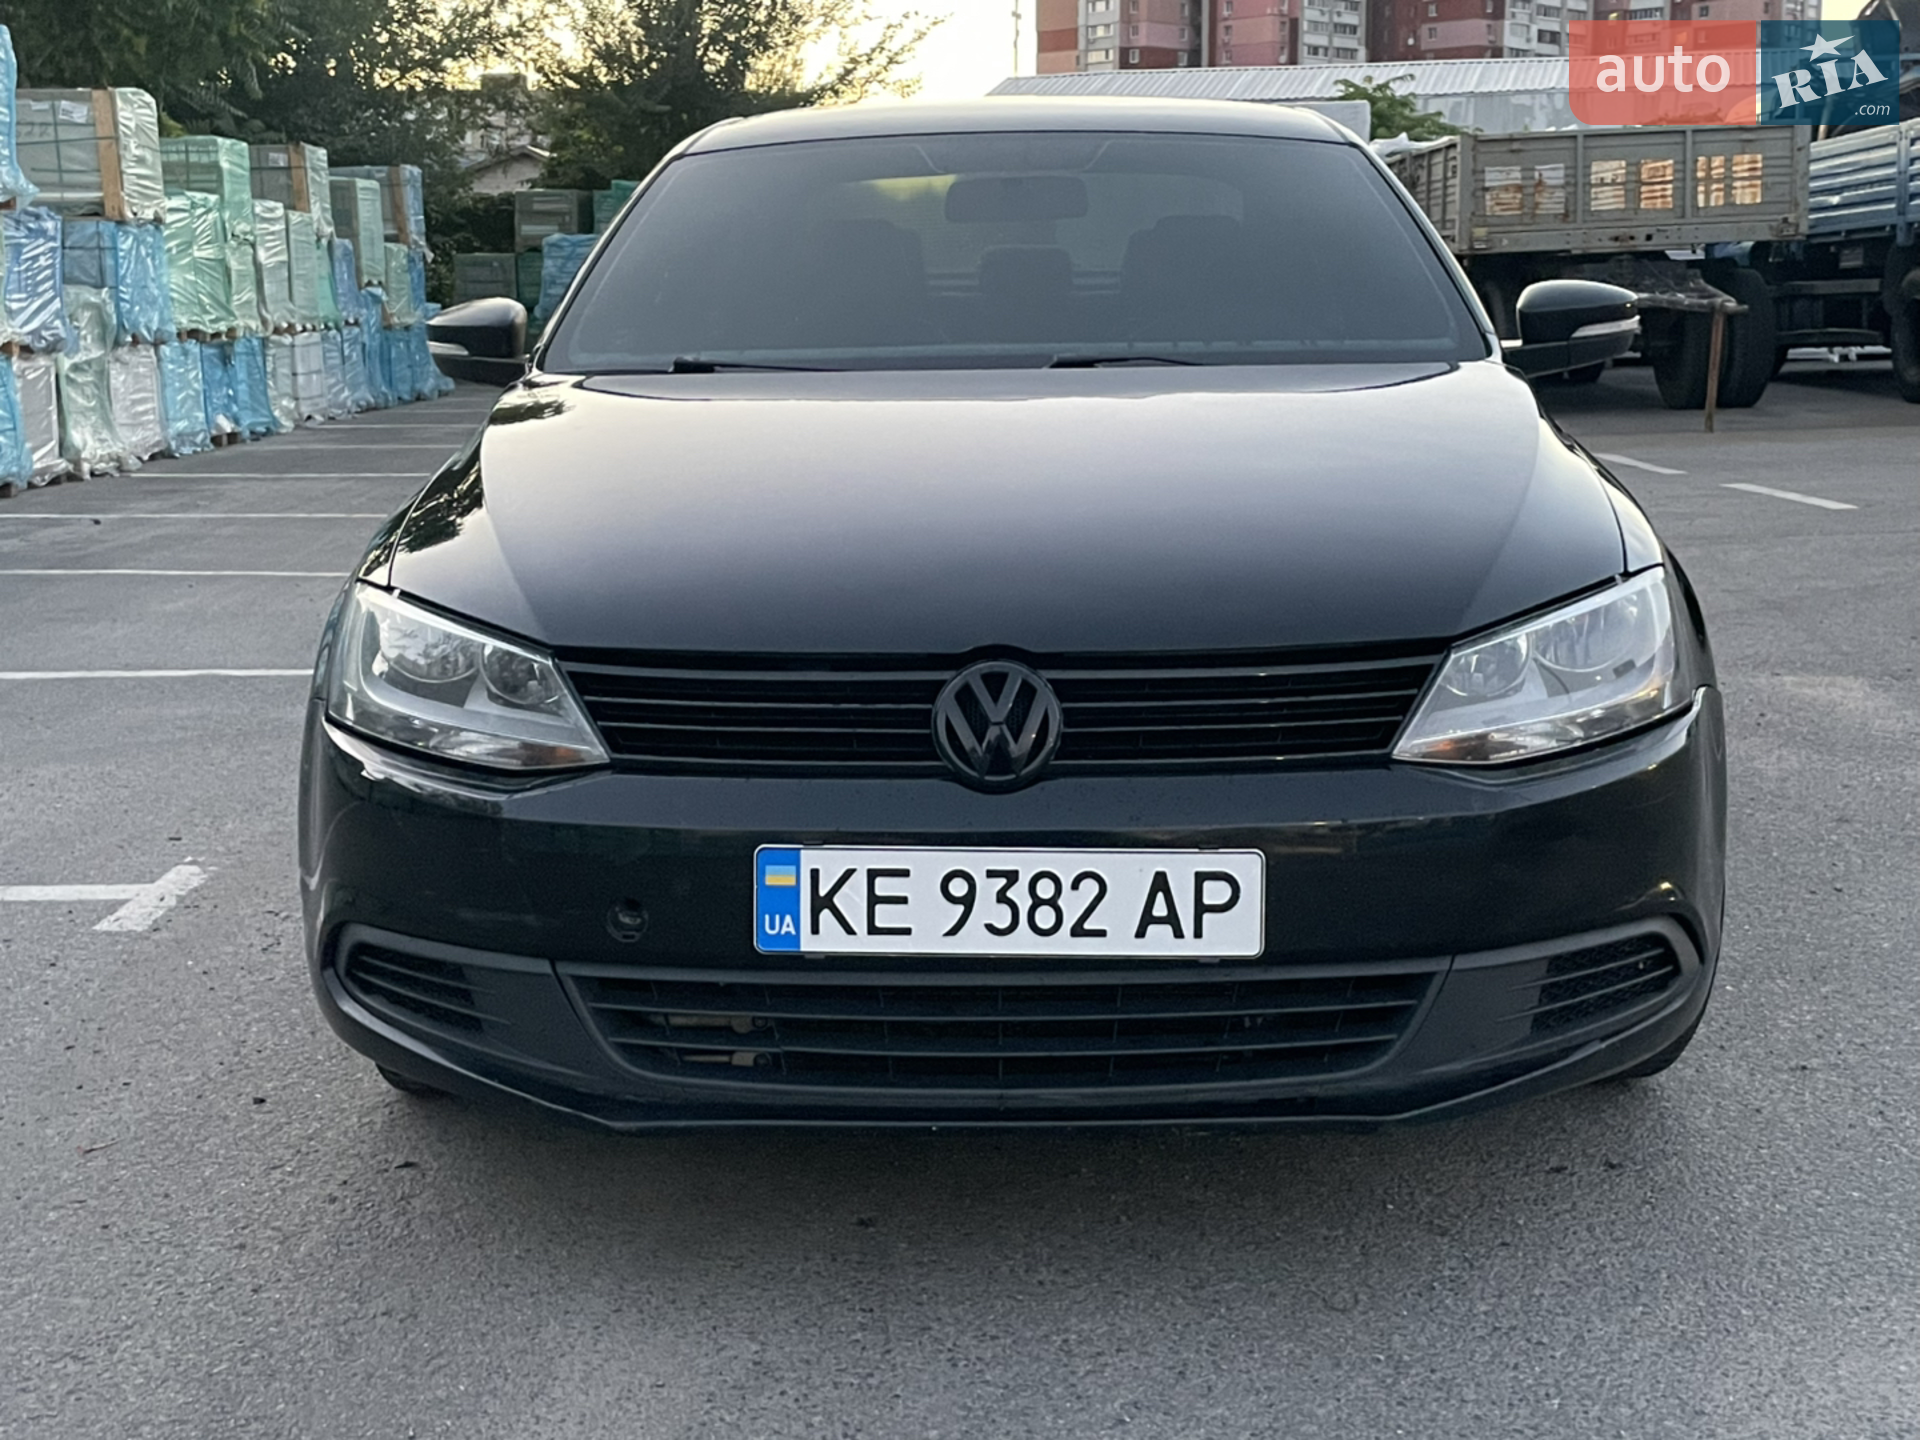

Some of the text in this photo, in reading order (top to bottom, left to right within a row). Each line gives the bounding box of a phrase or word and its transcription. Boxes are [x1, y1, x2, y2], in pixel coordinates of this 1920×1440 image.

[765, 914, 796, 935] UA
[810, 868, 1242, 940] KE 9382 AP
